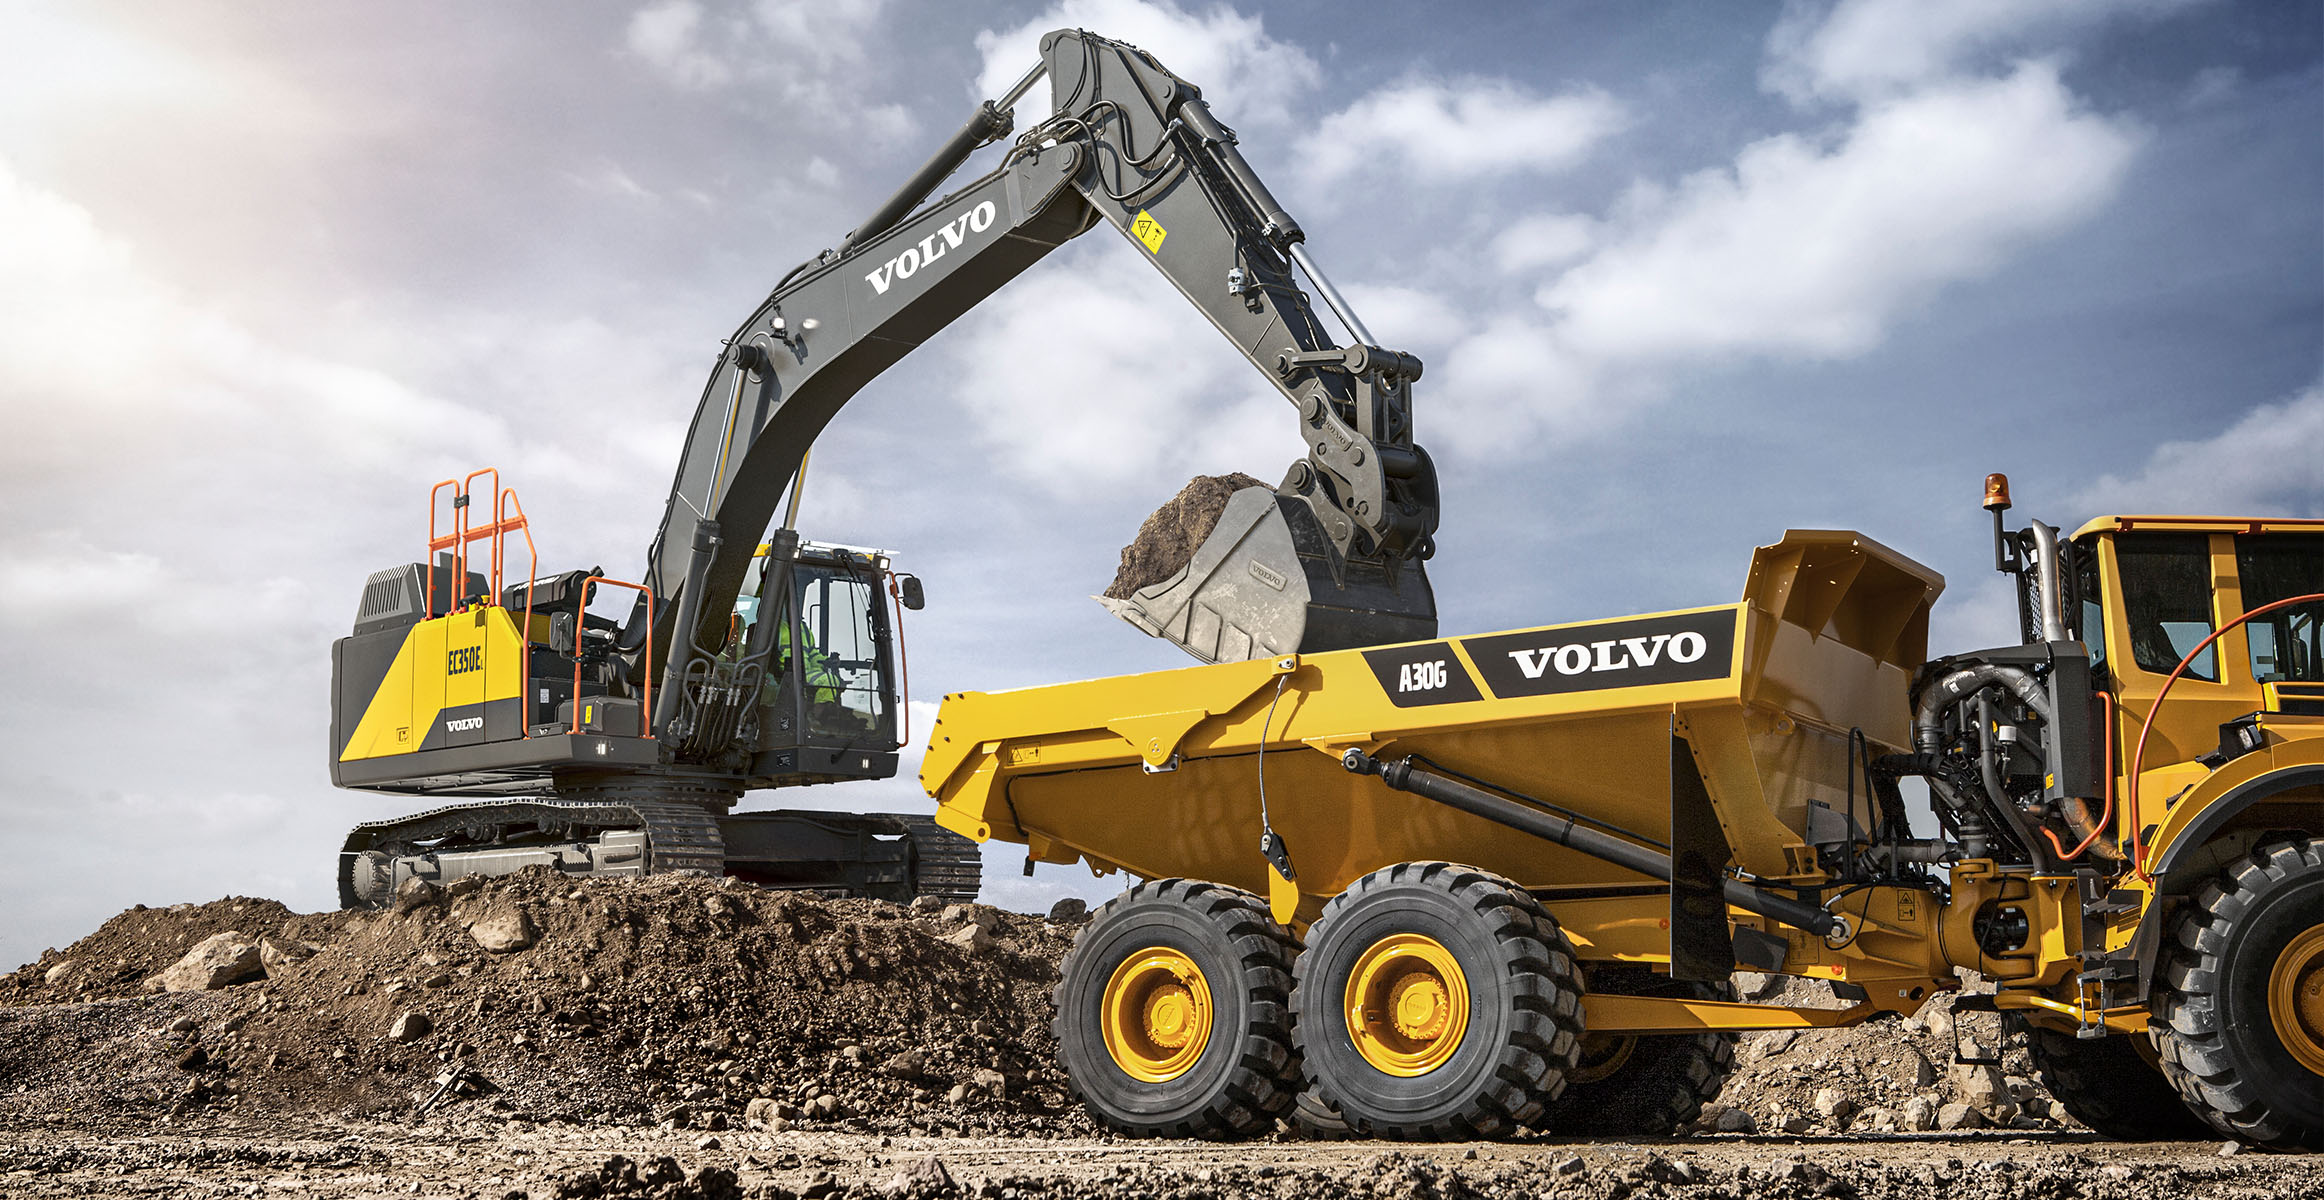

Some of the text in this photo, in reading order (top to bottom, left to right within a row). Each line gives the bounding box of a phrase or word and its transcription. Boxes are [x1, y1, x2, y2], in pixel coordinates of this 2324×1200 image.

[865, 201, 996, 295] VOLVO
[1253, 565, 1281, 586] VOLVO
[1508, 631, 1707, 679] VOLVO
[1399, 660, 1447, 692] A30G
[446, 716, 483, 732] VOLVO
